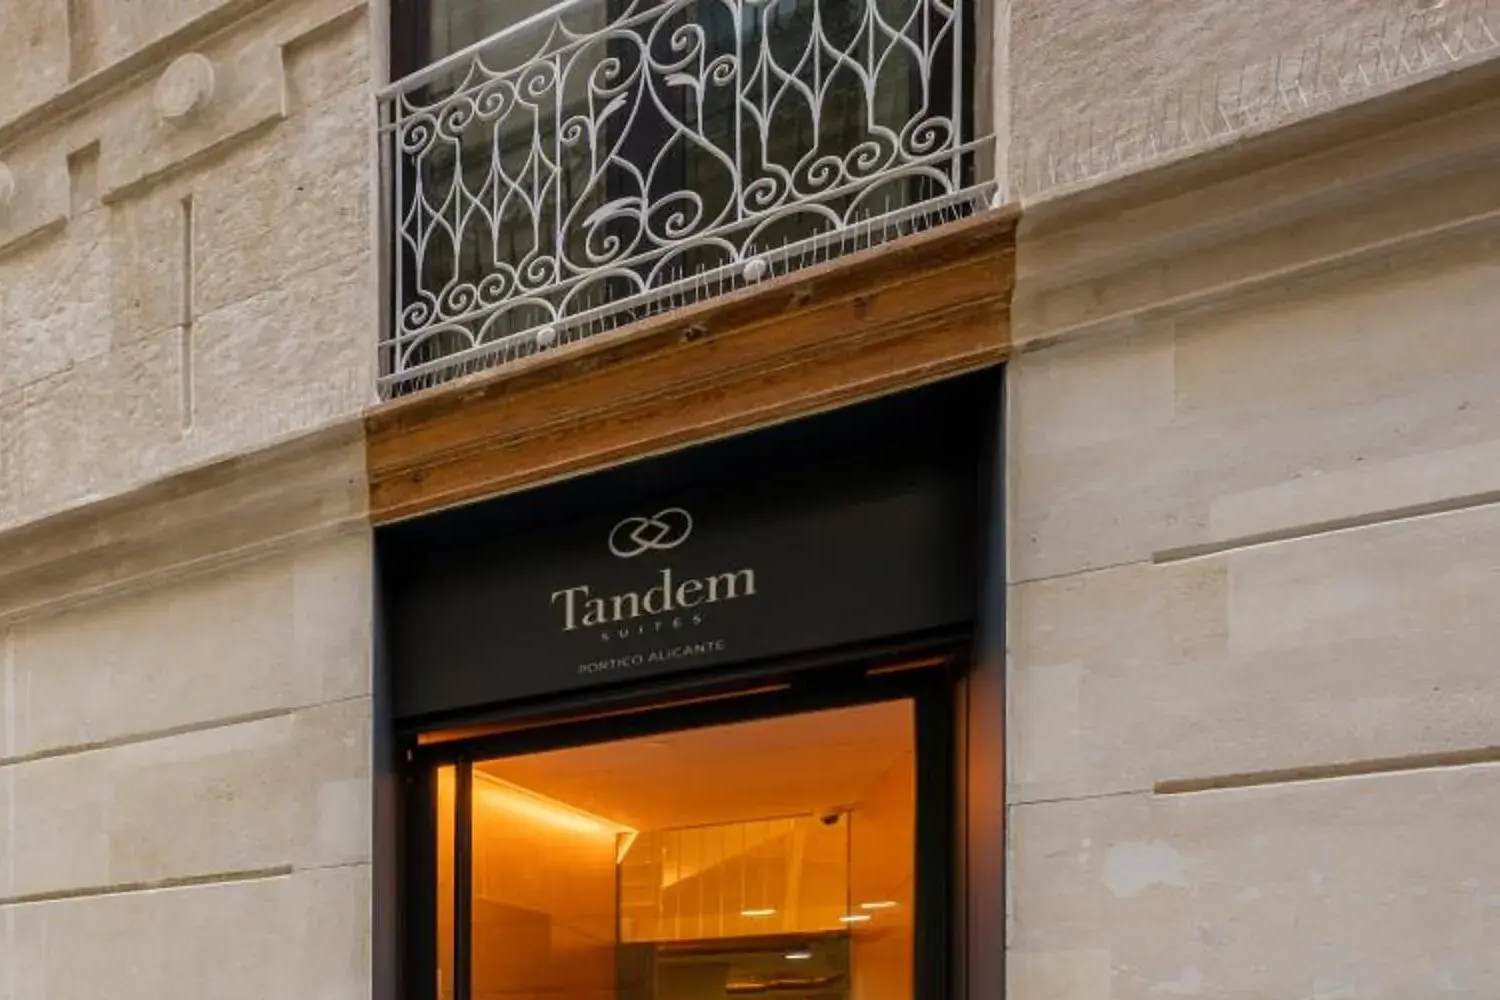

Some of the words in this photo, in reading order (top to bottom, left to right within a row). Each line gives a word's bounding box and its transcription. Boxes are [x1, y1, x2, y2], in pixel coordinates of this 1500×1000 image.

[551, 568, 757, 631] Tandem
[601, 614, 704, 641] SUITES
[647, 639, 726, 663] ALICANTE
